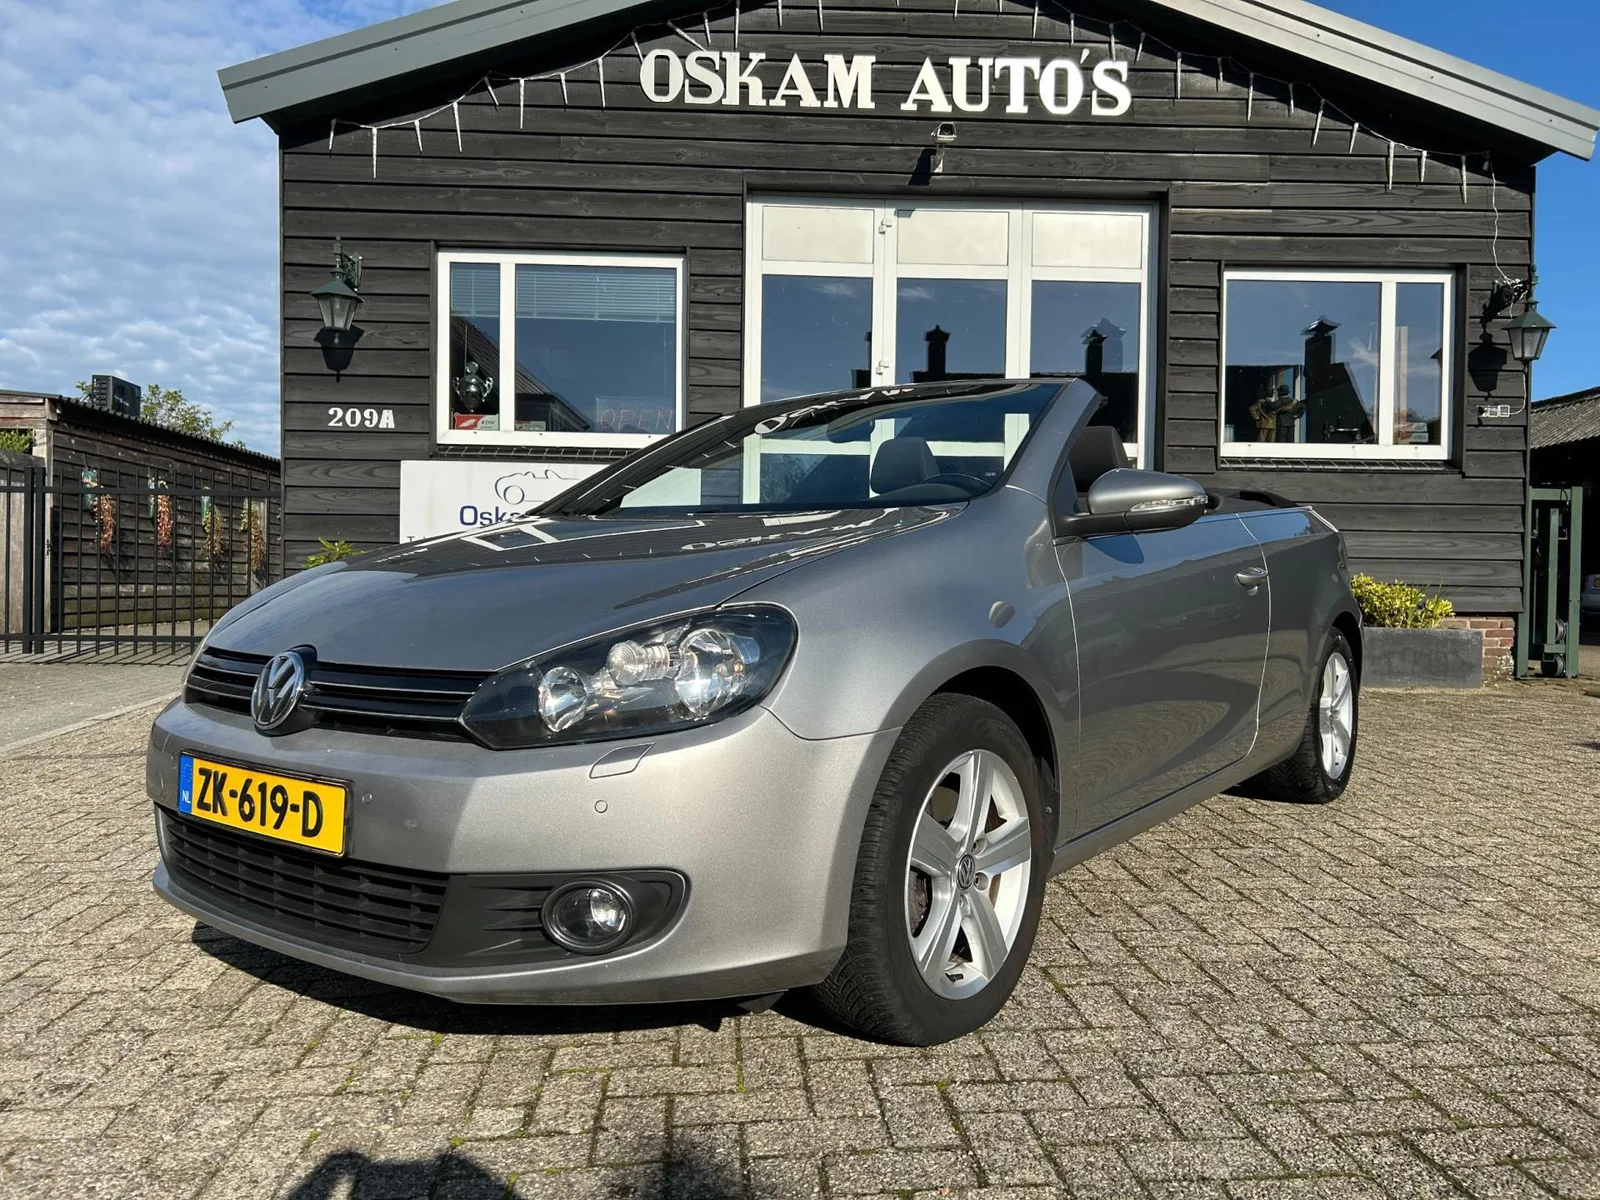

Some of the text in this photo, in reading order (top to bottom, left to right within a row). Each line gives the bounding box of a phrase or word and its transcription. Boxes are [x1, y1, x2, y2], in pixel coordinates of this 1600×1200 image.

[639, 49, 876, 110] OSKAM
[327, 406, 395, 429] 209A
[600, 408, 673, 430] OPEN
[181, 789, 191, 804] NL
[196, 766, 324, 838] ZK-619-D
